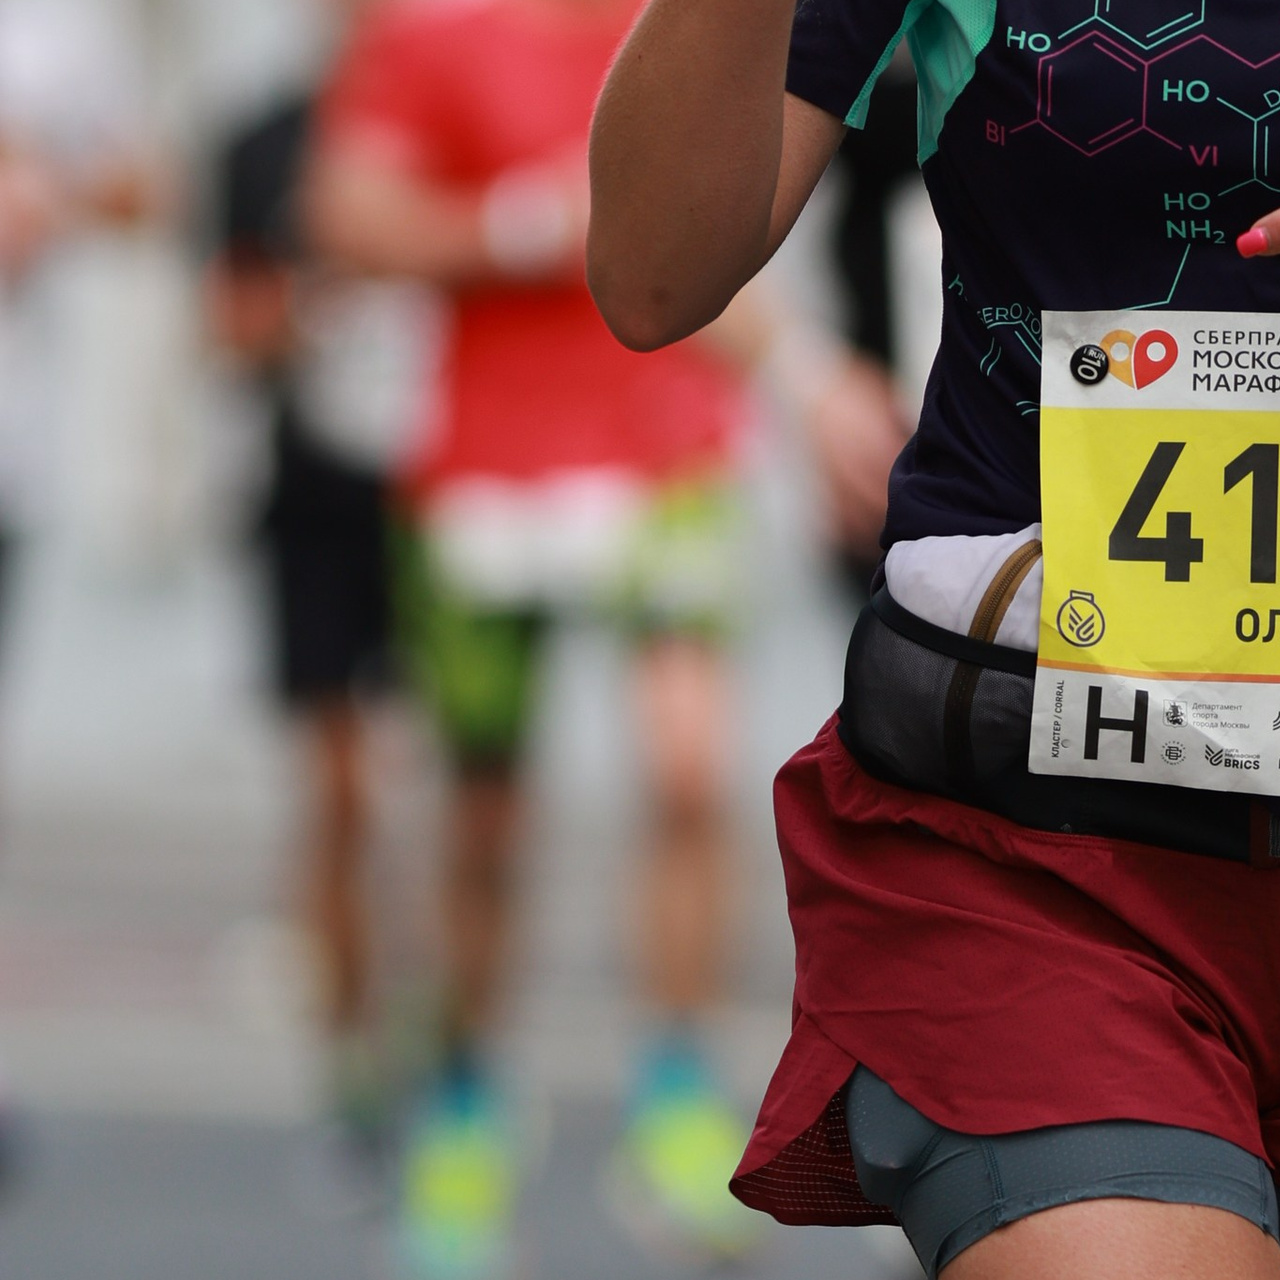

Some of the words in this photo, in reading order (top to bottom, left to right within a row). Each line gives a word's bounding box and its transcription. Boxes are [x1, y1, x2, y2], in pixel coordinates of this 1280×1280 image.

[1006, 25, 1051, 53] HO
[1163, 79, 1210, 103] HO
[986, 119, 1005, 146] BI
[1188, 145, 1218, 167] VI
[1164, 192, 1211, 210] HO
[1166, 219, 1226, 244] NH2
[977, 303, 1042, 340] EROTO
[1077, 356, 1101, 380] 10
[1054, 680, 1065, 713] CORRAL
[1192, 702, 1243, 711] Департамент
[1192, 712, 1218, 720] спорта
[1192, 721, 1218, 729] города
[1220, 721, 1250, 729] Москвы
[1051, 720, 1062, 758] КЛАСТЕР
[1224, 758, 1260, 770] BRICS
